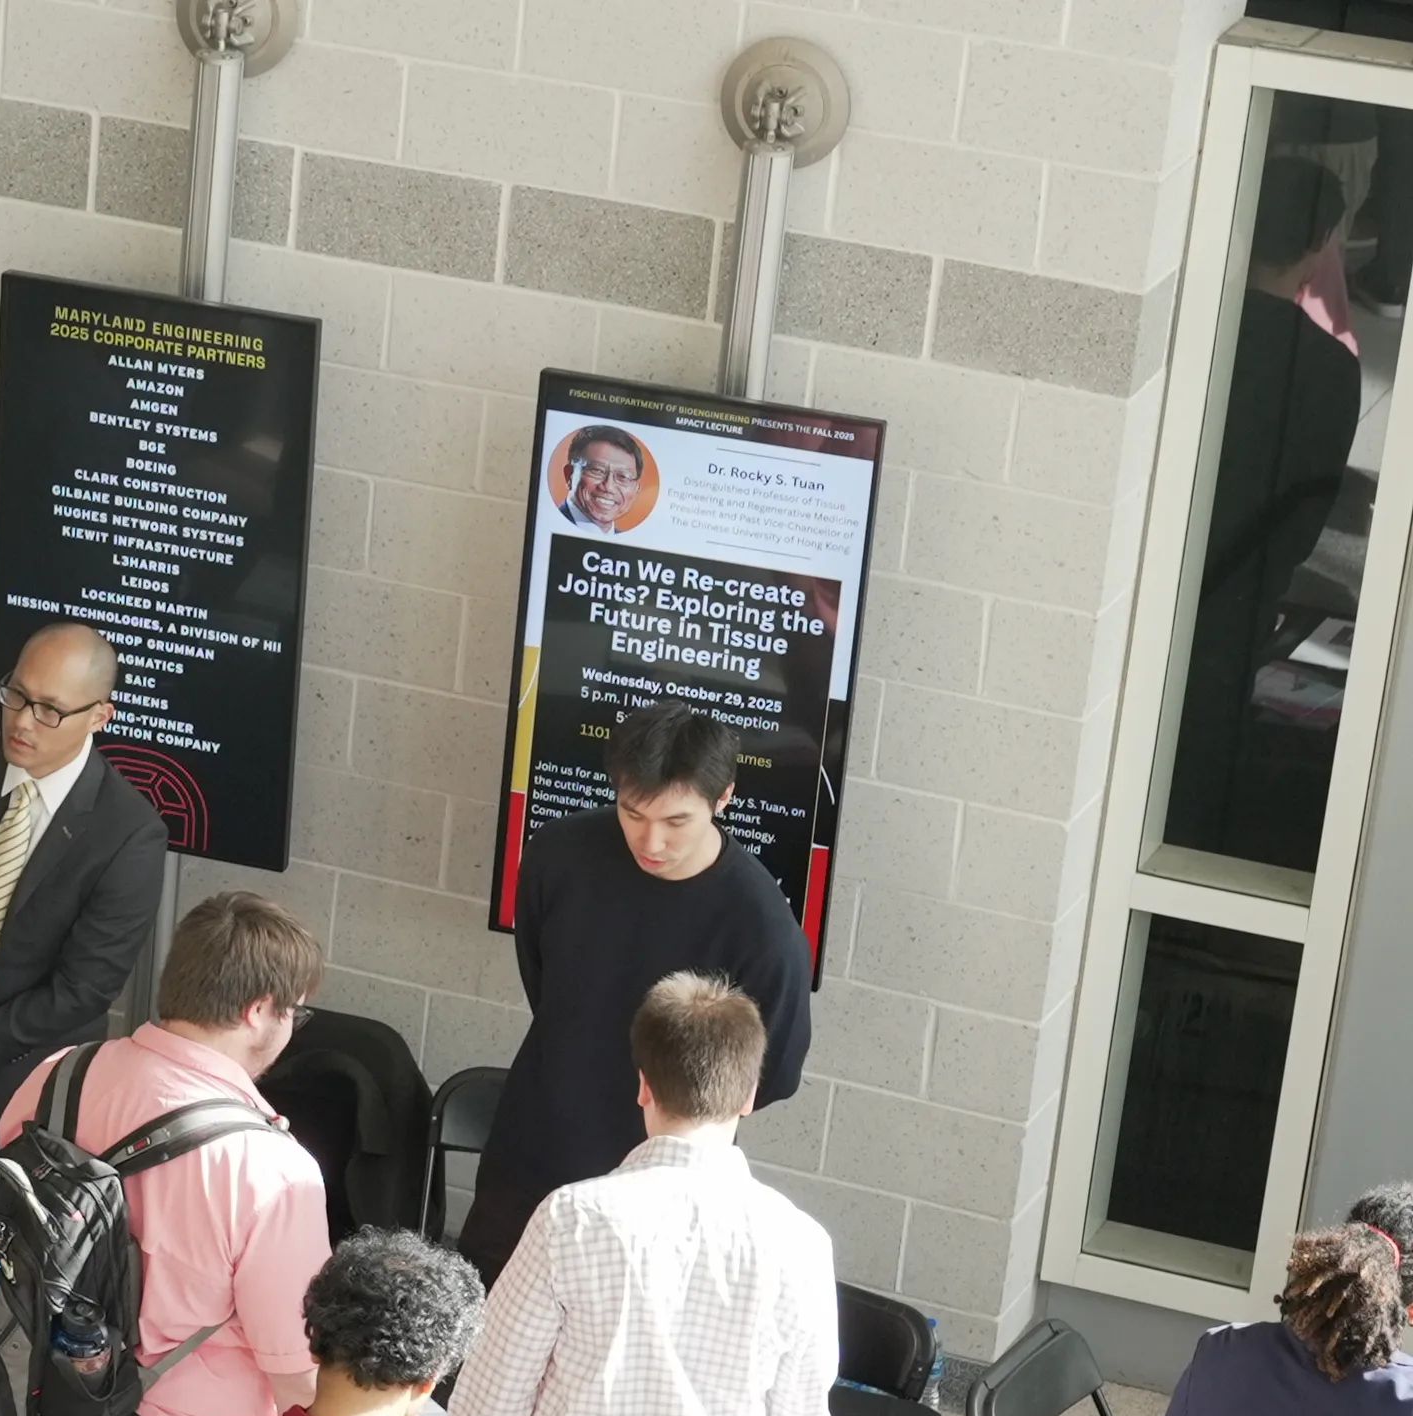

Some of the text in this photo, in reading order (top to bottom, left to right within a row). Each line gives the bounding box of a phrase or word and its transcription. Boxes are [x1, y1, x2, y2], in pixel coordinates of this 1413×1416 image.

[54, 305, 264, 352] MARYLAND ENGINEERING
[50, 322, 266, 370] 2025 CORPORATE PARTNERS
[108, 355, 205, 381] ALLAN MYERS
[126, 378, 185, 397] AMAZON
[130, 399, 179, 416] AMGEN
[569, 389, 607, 402] FISCHELL
[609, 395, 664, 411] DEPARTMENT
[666, 404, 677, 413] OF
[679, 405, 750, 425] BIOENGINEERING
[751, 417, 793, 432] PRESENTS
[795, 424, 811, 435] THE
[812, 427, 833, 438] FALL
[89, 411, 218, 443] BENTLEY SYSTEMS
[706, 420, 743, 435] LECTURE
[138, 440, 166, 455] BGE
[126, 457, 177, 476] BOEING
[708, 463, 825, 492] Dr. Rocky S. Tuan
[74, 469, 228, 505] CLARK CONSTRUCTION
[684, 477, 846, 512] Distinguished Professor of Tissue
[52, 484, 248, 528] GILBANE BUILDING COMPANY
[667, 488, 859, 528] Engineering and Regenerative Medicine
[53, 504, 244, 548] HUGHES NETWORK SYSTEMS
[670, 503, 855, 540] President and Past Vice-Chancellor of
[670, 516, 850, 556] The Chinese University of Hong Kong
[62, 525, 234, 565] KIEWIT INFRASTRUCTURE
[113, 554, 180, 576] L3HARRIS
[582, 551, 807, 608] Can We Re-create
[121, 575, 170, 594] LEIDOS
[81, 587, 208, 621] LOCKHEED MARTIN
[558, 573, 825, 636] Joints? Exploring the
[7, 594, 282, 653] MISSION TECHNOLOGIES, A DIVISION OF HII
[589, 602, 789, 655] Future in Tissue
[96, 630, 215, 660] THROP GRUMMAN
[611, 631, 762, 680] Engineering
[117, 652, 184, 674] AGMATICS
[125, 673, 156, 689] SAIC
[582, 667, 783, 713] Wednesday, October 29, 2025
[110, 690, 169, 711] SIEMENS
[580, 686, 589, 698] 5
[592, 690, 621, 704] p.m.
[711, 708, 779, 732] Reception
[113, 710, 194, 734] ING-TURNER
[580, 724, 610, 740] 1101
[102, 724, 221, 754] UCTION COMPANY
[534, 760, 607, 782] Join us for an
[736, 753, 772, 769] ames
[534, 775, 616, 801] the cutting-edg
[531, 804, 563, 819] Come
[728, 795, 806, 818] cky S. Tuan, on
[729, 811, 761, 825] smart
[724, 824, 777, 844] chnology.
